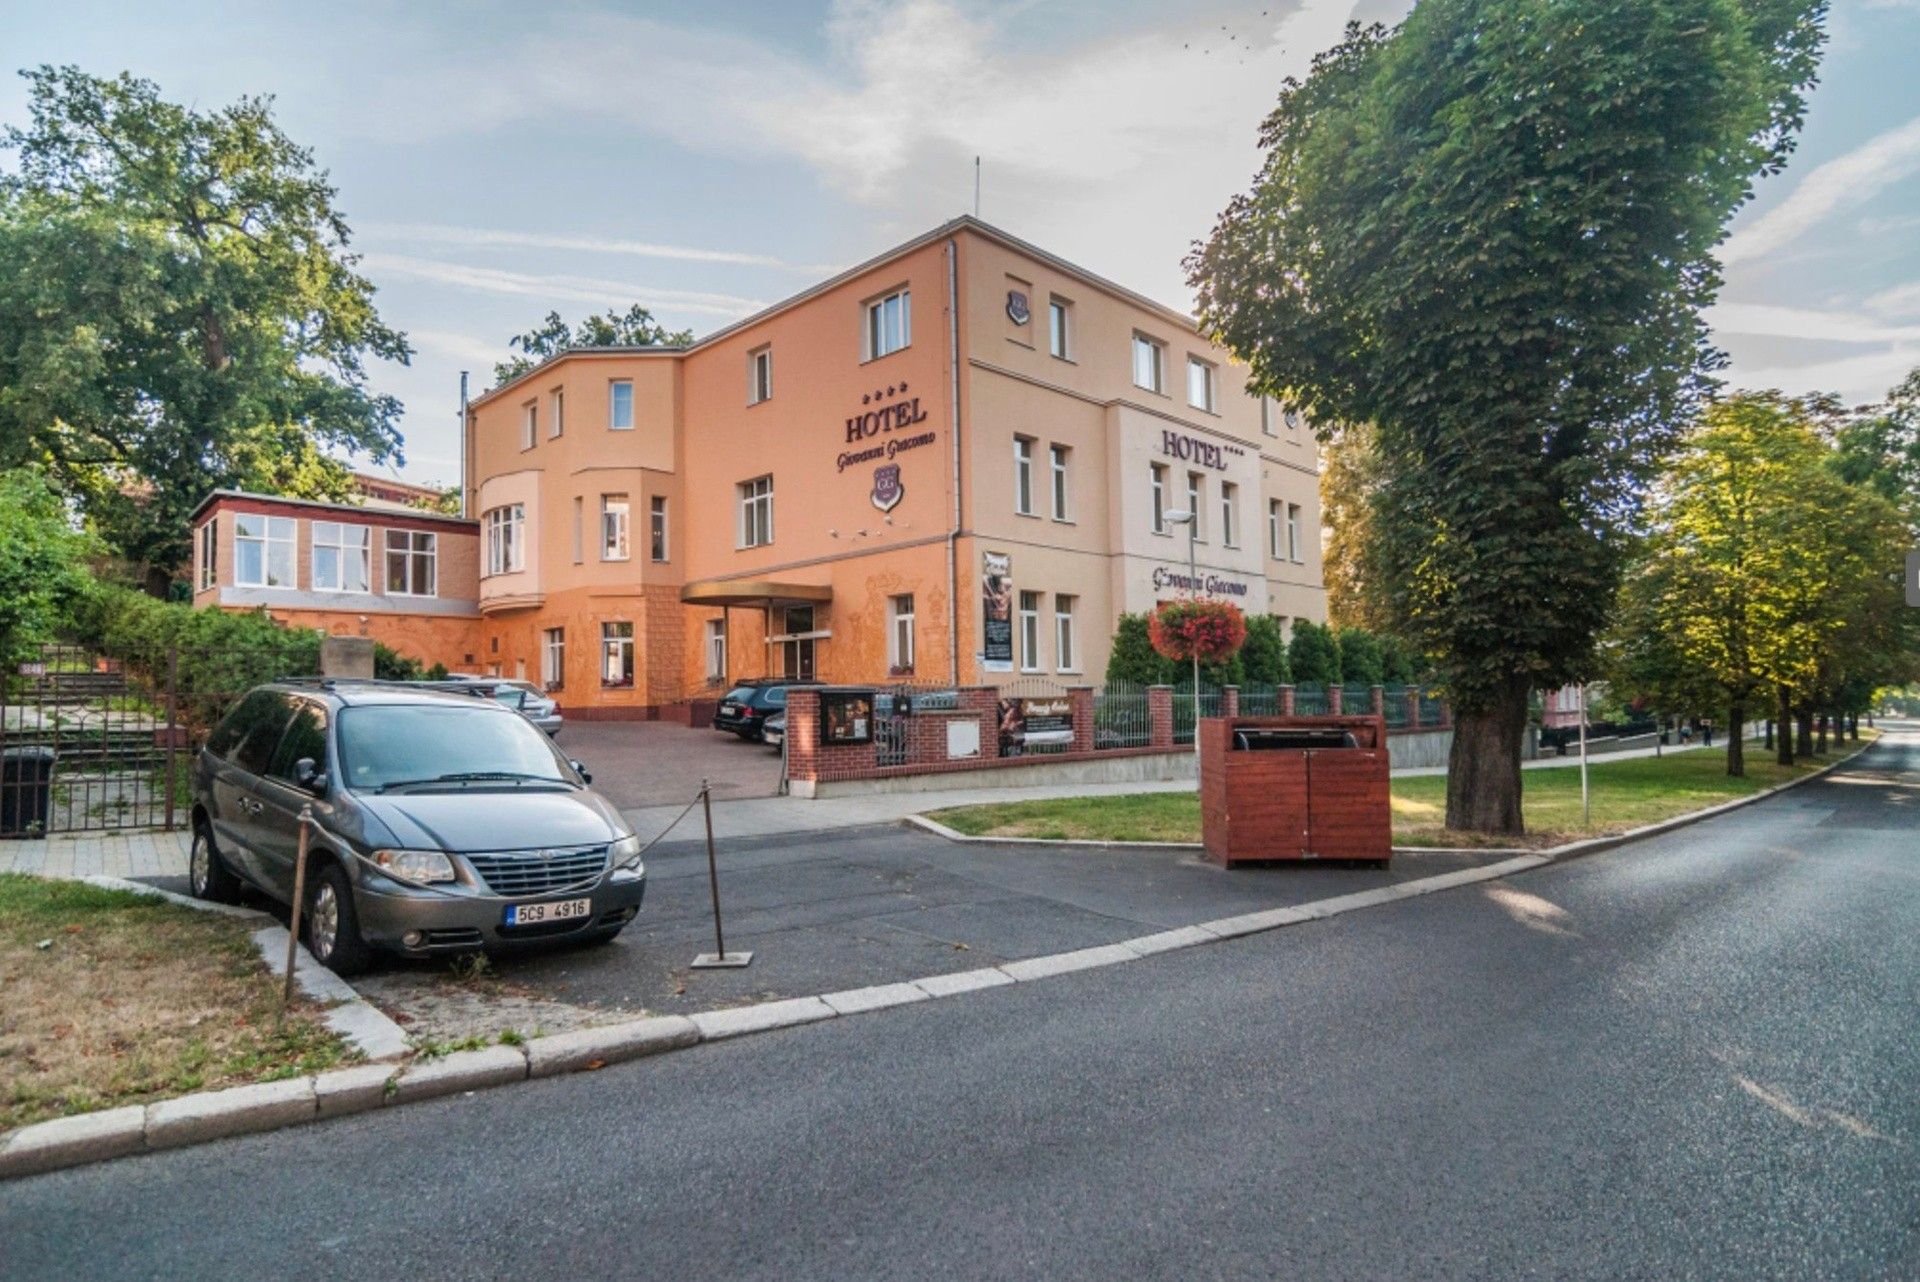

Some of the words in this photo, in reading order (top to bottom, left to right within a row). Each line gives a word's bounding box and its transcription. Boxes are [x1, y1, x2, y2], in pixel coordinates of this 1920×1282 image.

[845, 398, 928, 443] HOTEL
[1162, 429, 1228, 471] HOTEL
[519, 906, 544, 921] 5C9
[554, 901, 584, 917] 4916
